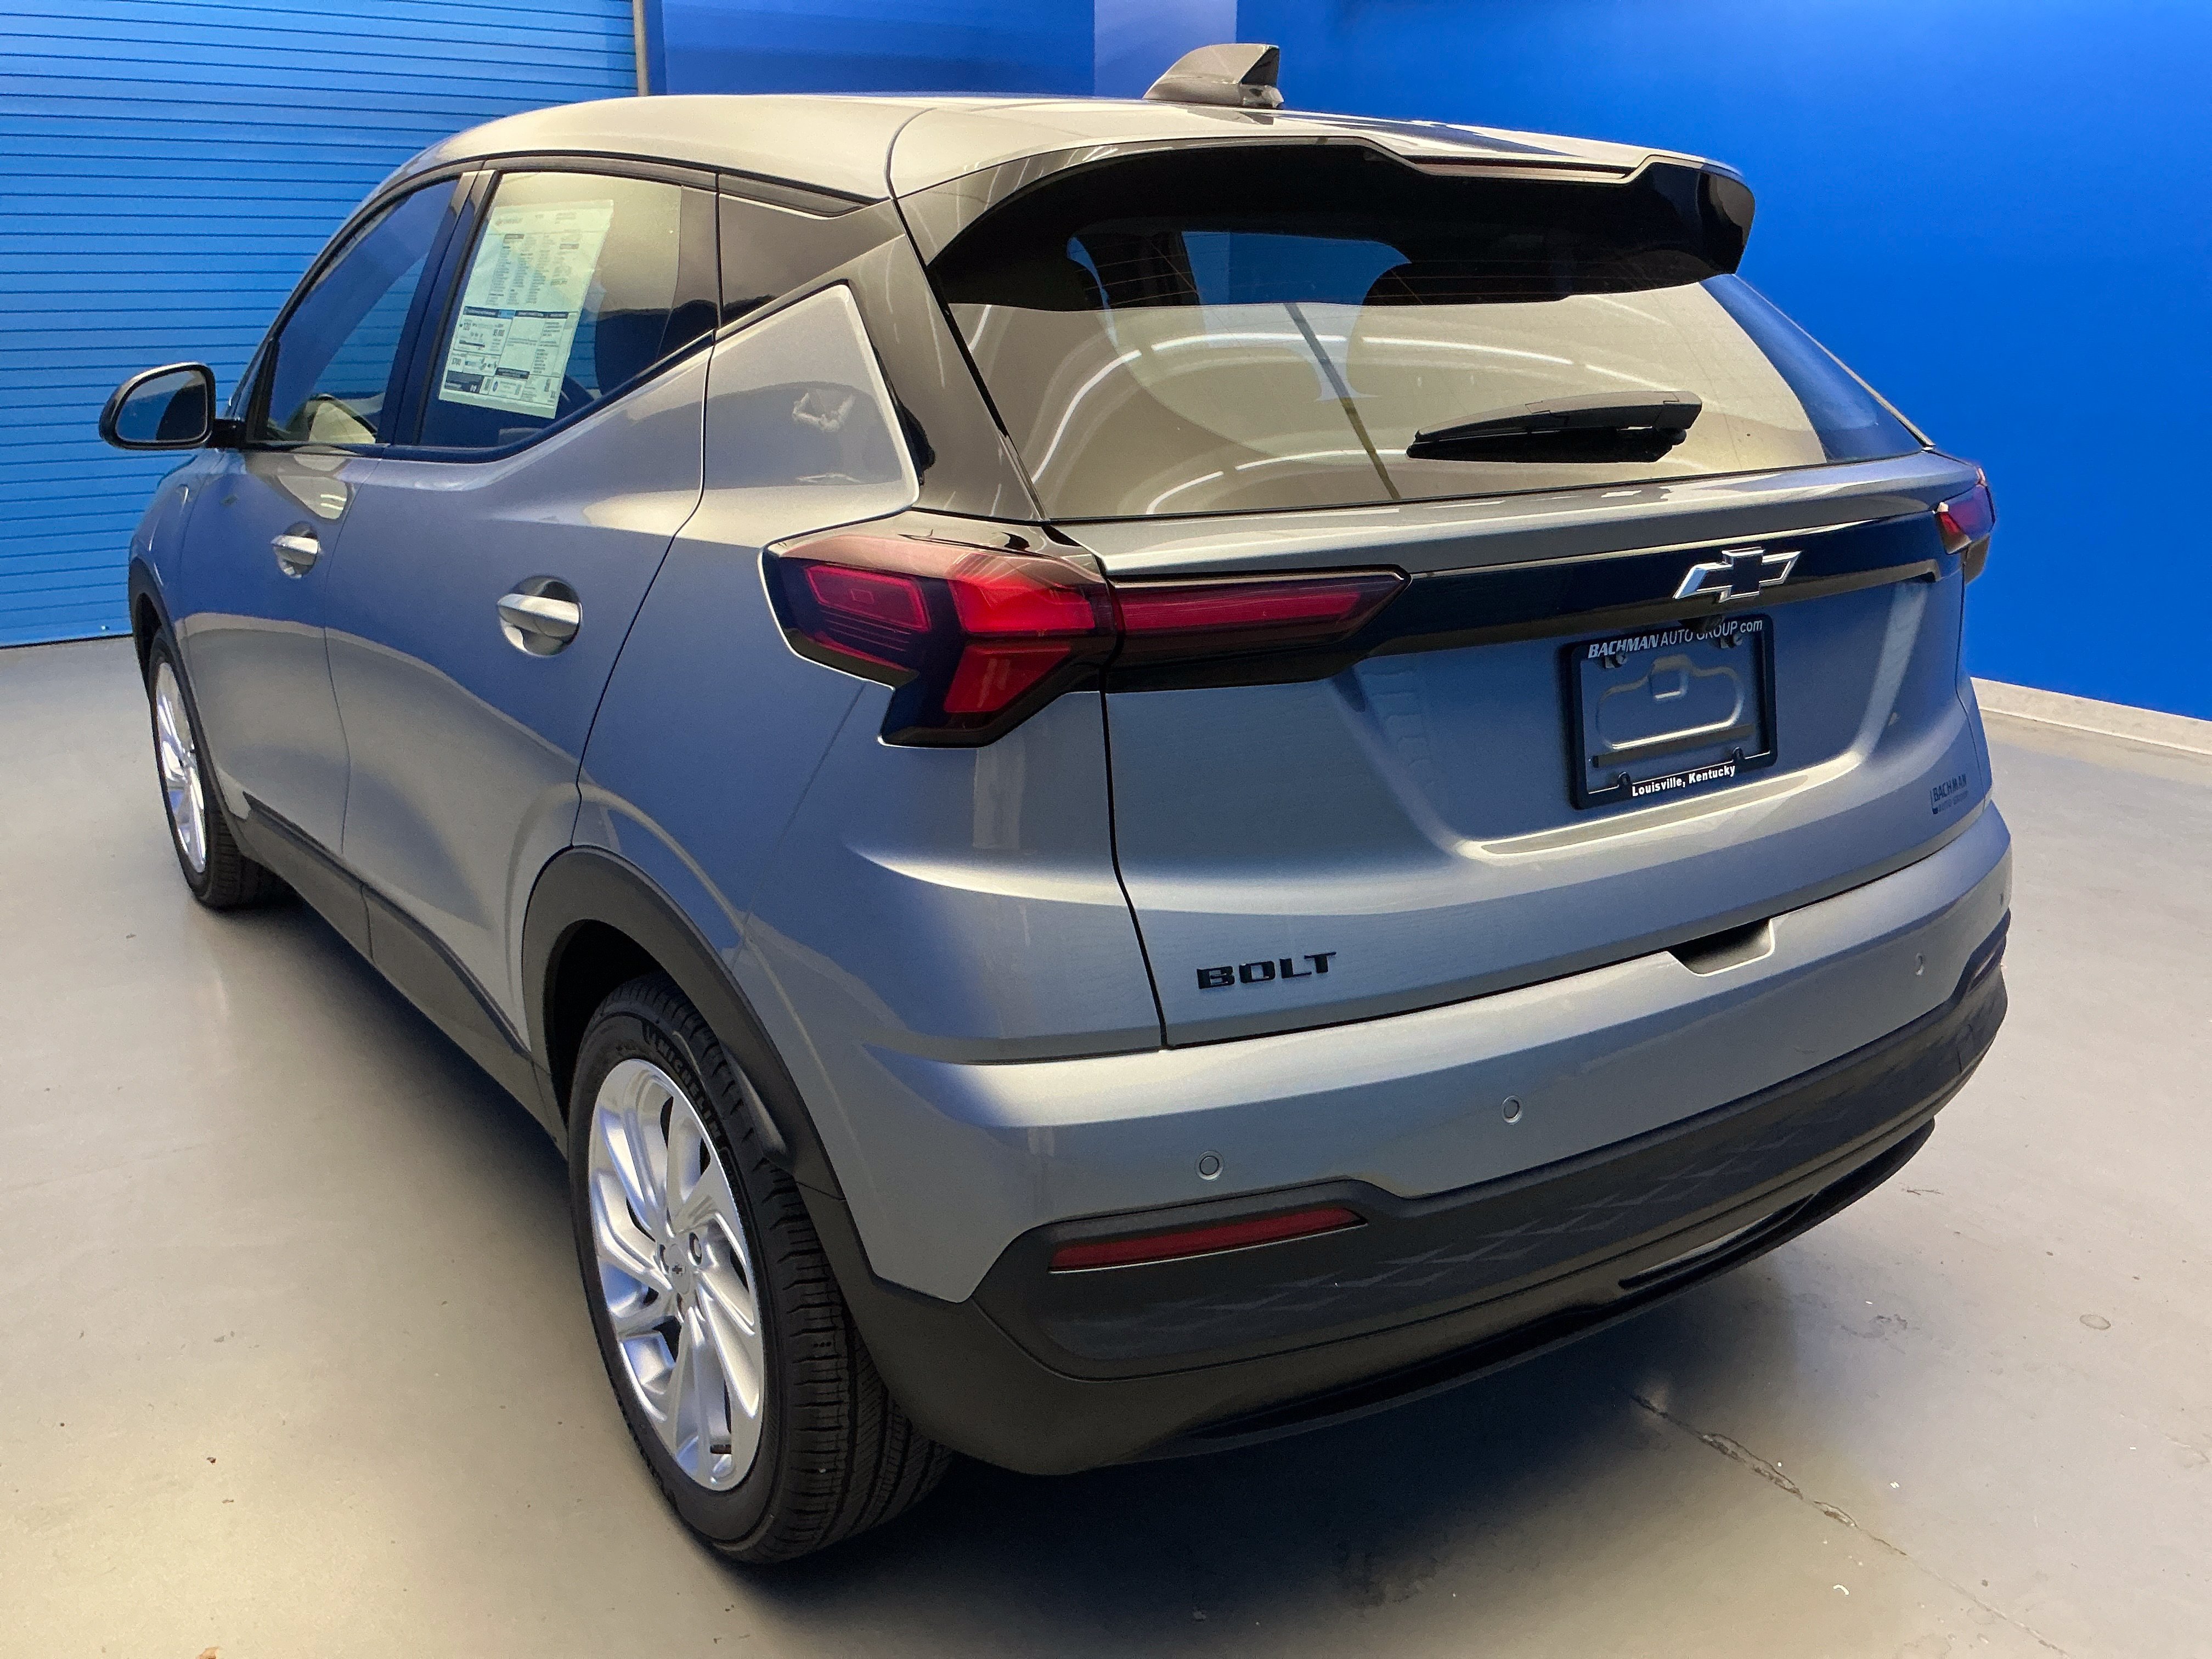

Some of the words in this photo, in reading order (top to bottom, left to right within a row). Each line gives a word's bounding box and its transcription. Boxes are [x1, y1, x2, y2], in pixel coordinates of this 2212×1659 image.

[1588, 635, 1659, 658] BACHMAN
[1661, 630, 1692, 646] AUTO
[1632, 777, 1685, 797] Louisville,
[1689, 765, 1735, 784] Kentucky
[1933, 774, 1967, 802] BACHMAN
[1197, 952, 1337, 989] BOLT
